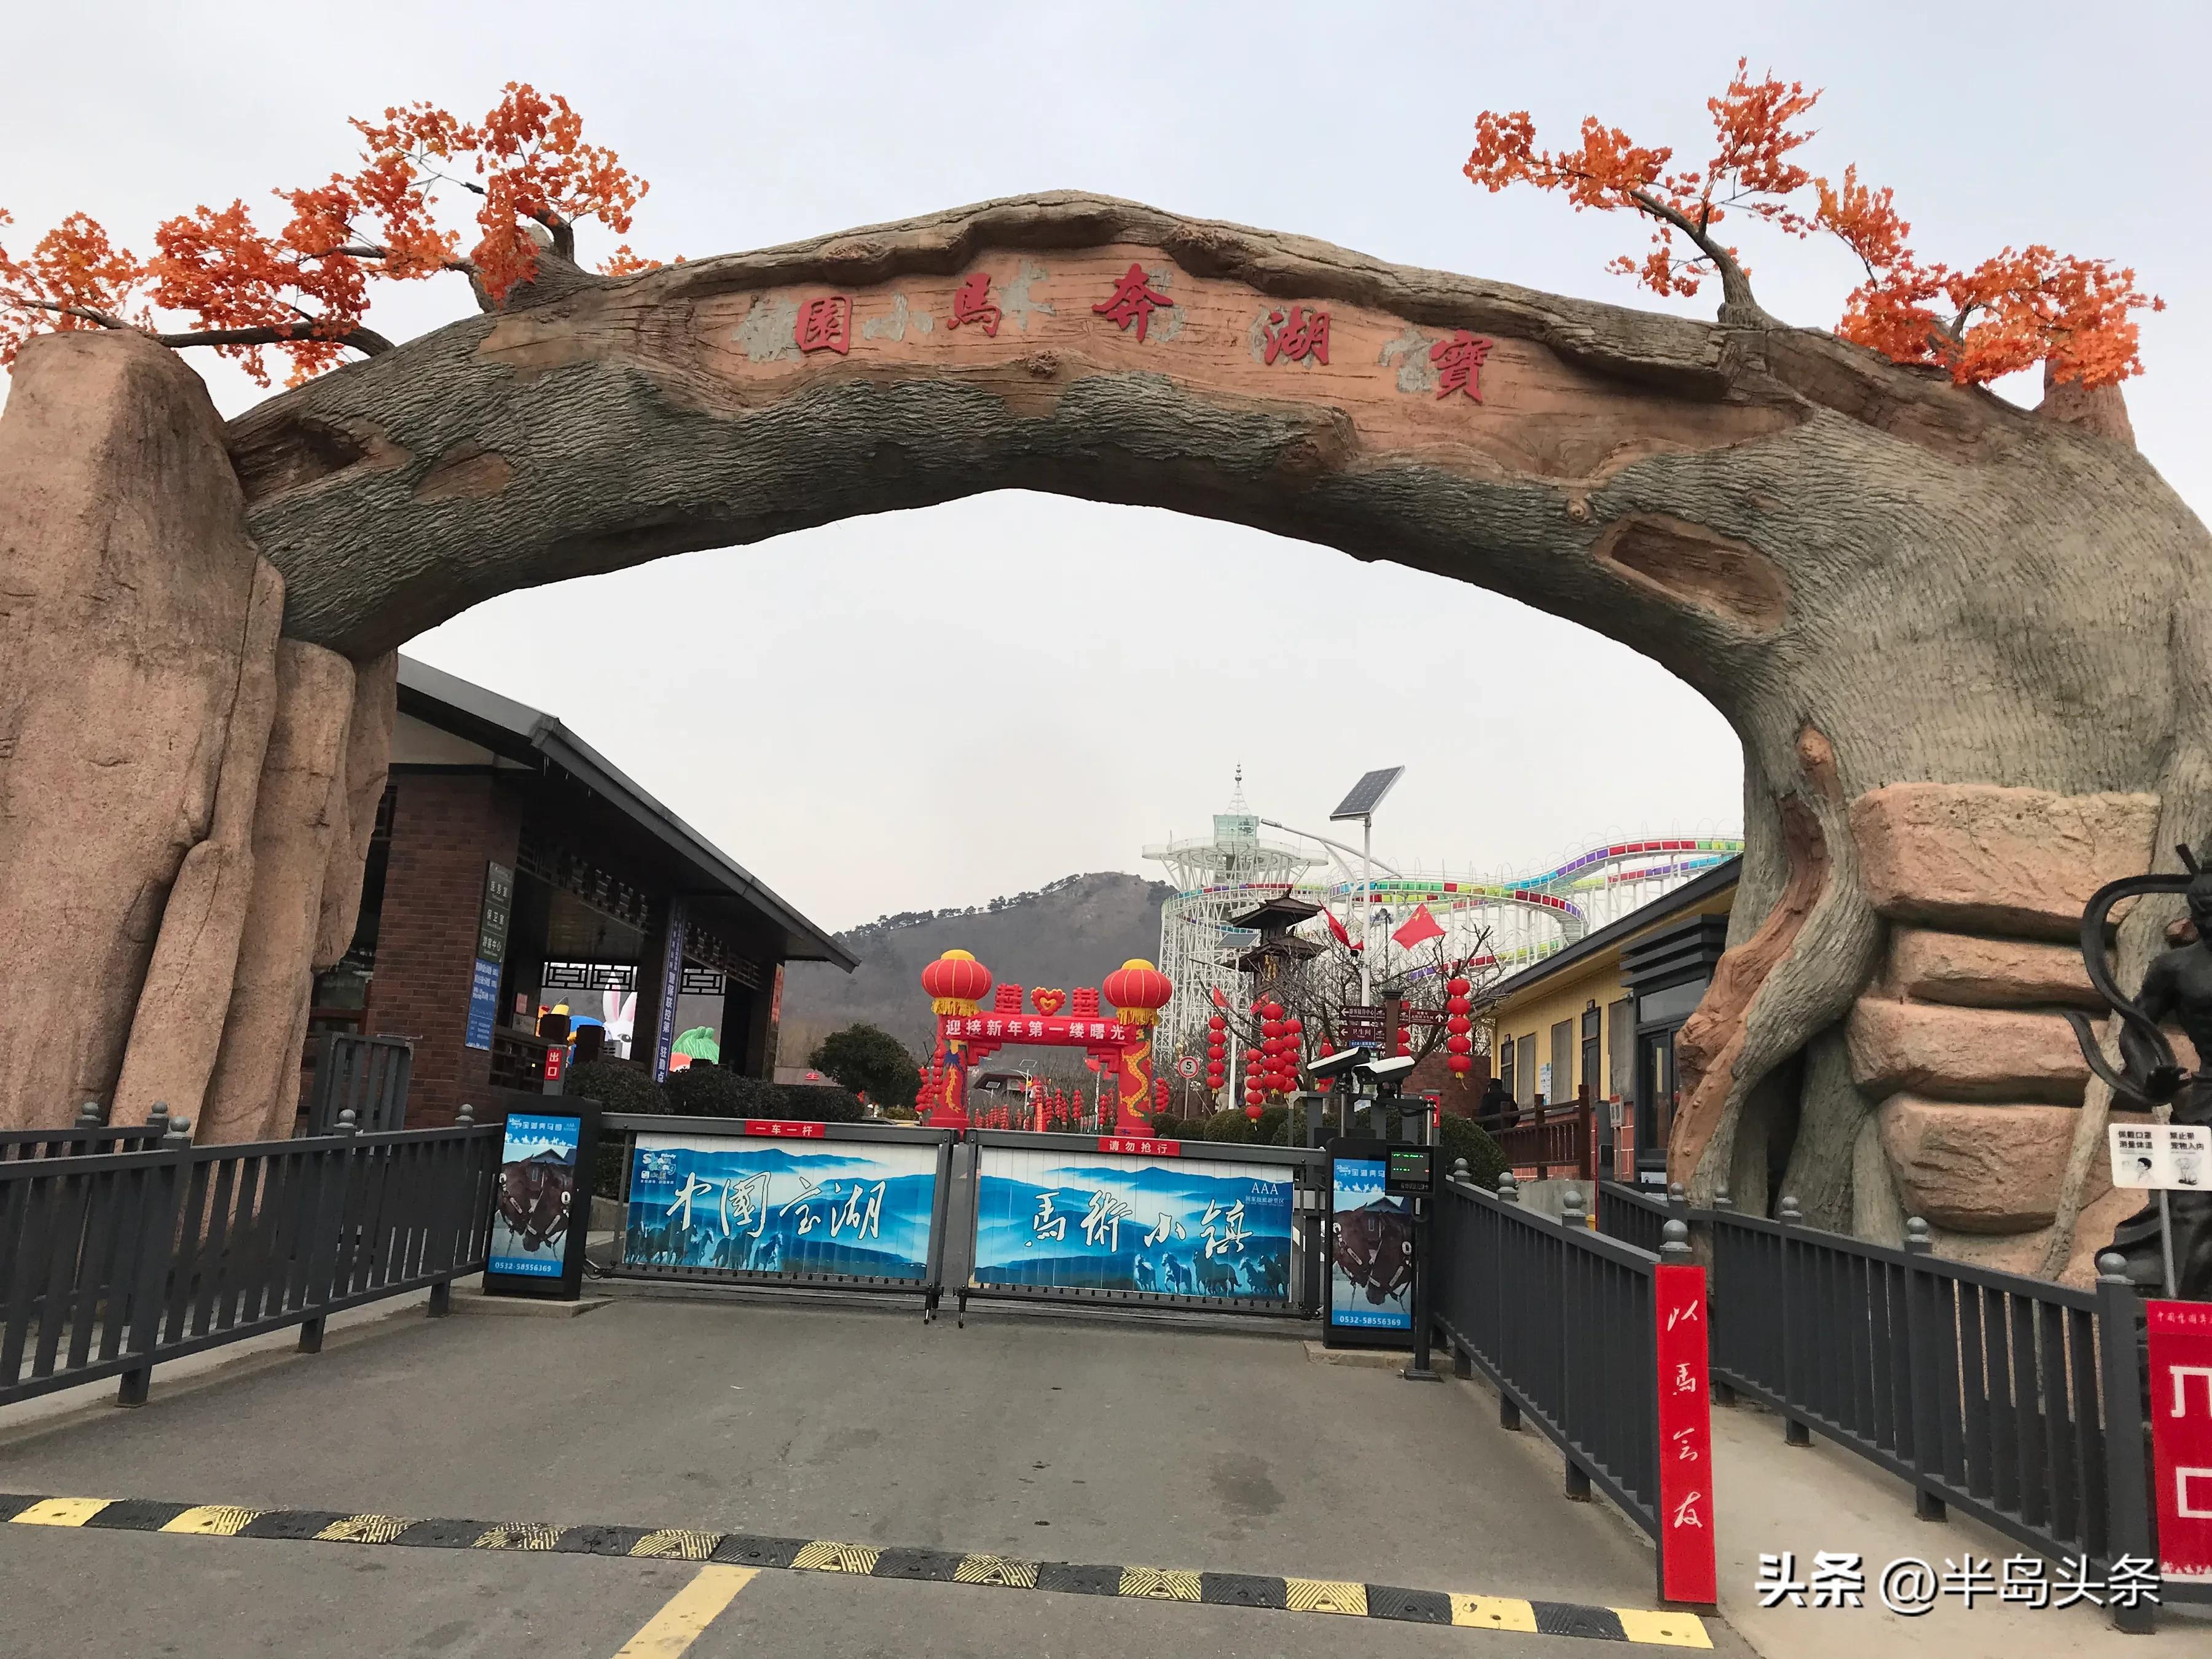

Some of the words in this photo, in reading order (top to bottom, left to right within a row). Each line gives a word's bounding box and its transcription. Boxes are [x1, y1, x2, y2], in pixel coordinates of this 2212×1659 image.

[946, 1019, 1126, 1040] 迎接新年第一缕曙光
[547, 1052, 559, 1076] 出口
[756, 1124, 812, 1136] 一车一杆
[1109, 1140, 1167, 1154] 请勿抢行
[1251, 1182, 1279, 1195] AAA
[495, 1262, 552, 1272] 0532-58556369
[1339, 1316, 1401, 1326] 0532-58556369
